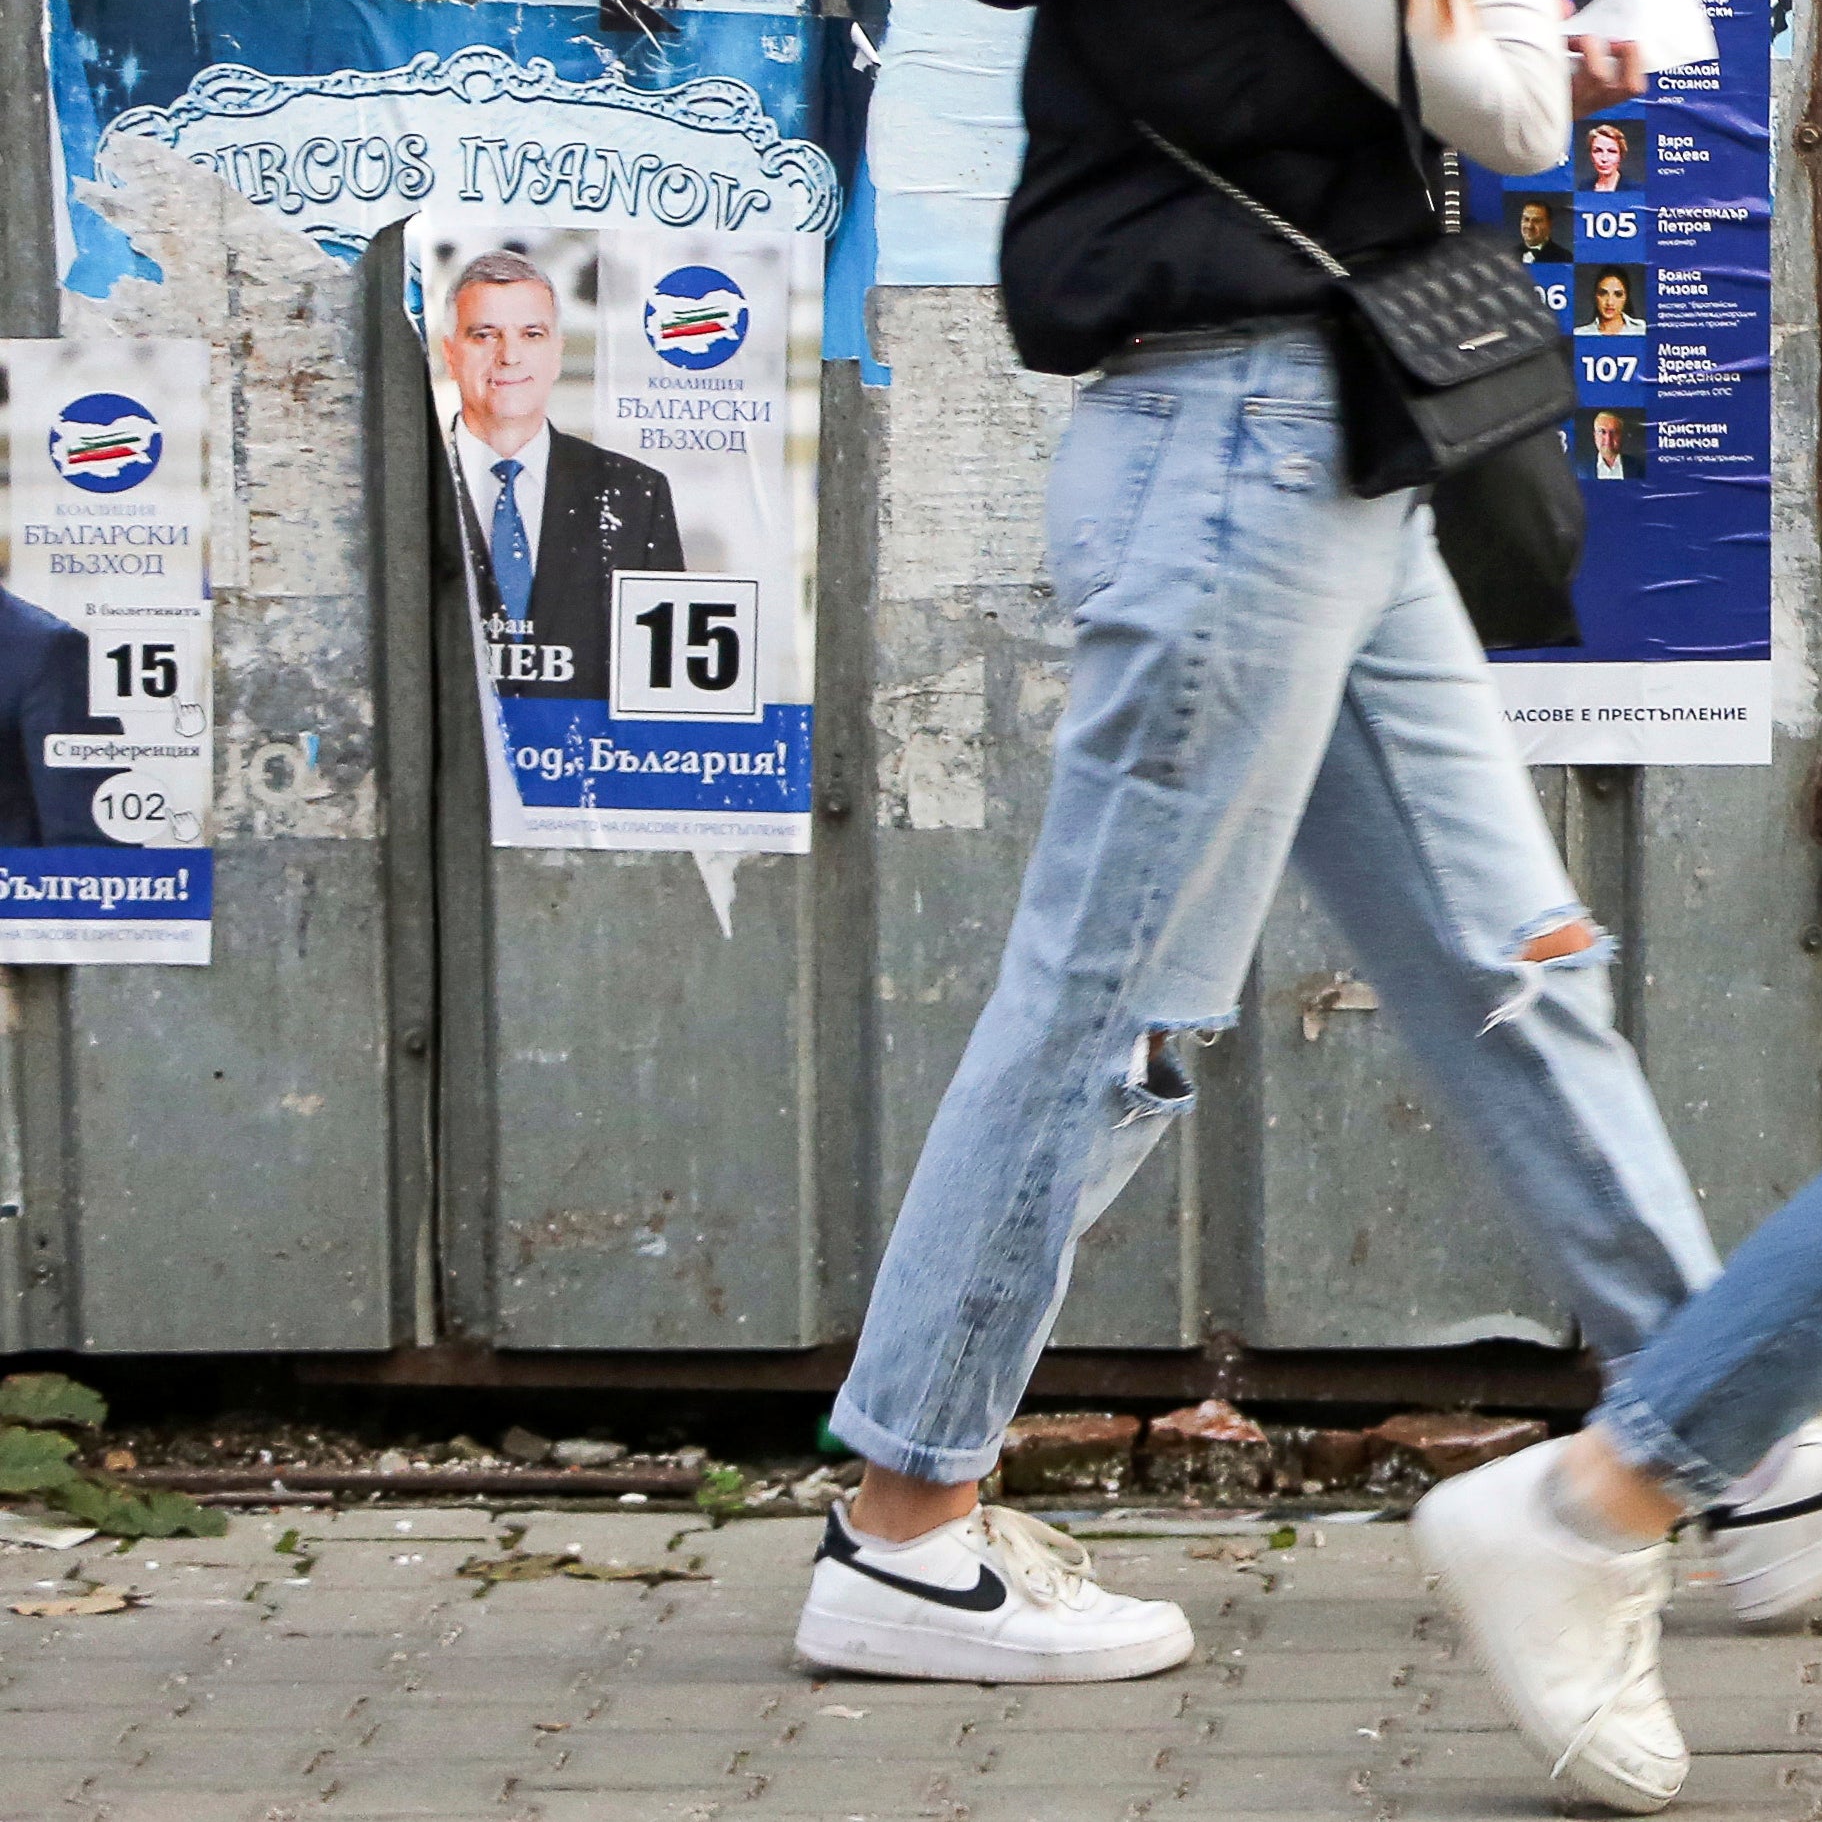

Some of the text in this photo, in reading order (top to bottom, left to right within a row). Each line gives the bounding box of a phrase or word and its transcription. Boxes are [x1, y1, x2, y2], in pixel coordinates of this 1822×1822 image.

[459, 135, 772, 233] IVANOV
[1582, 211, 1639, 239] 105
[106, 640, 180, 701] 15
[634, 601, 740, 690] 15
[99, 793, 167, 820] 102
